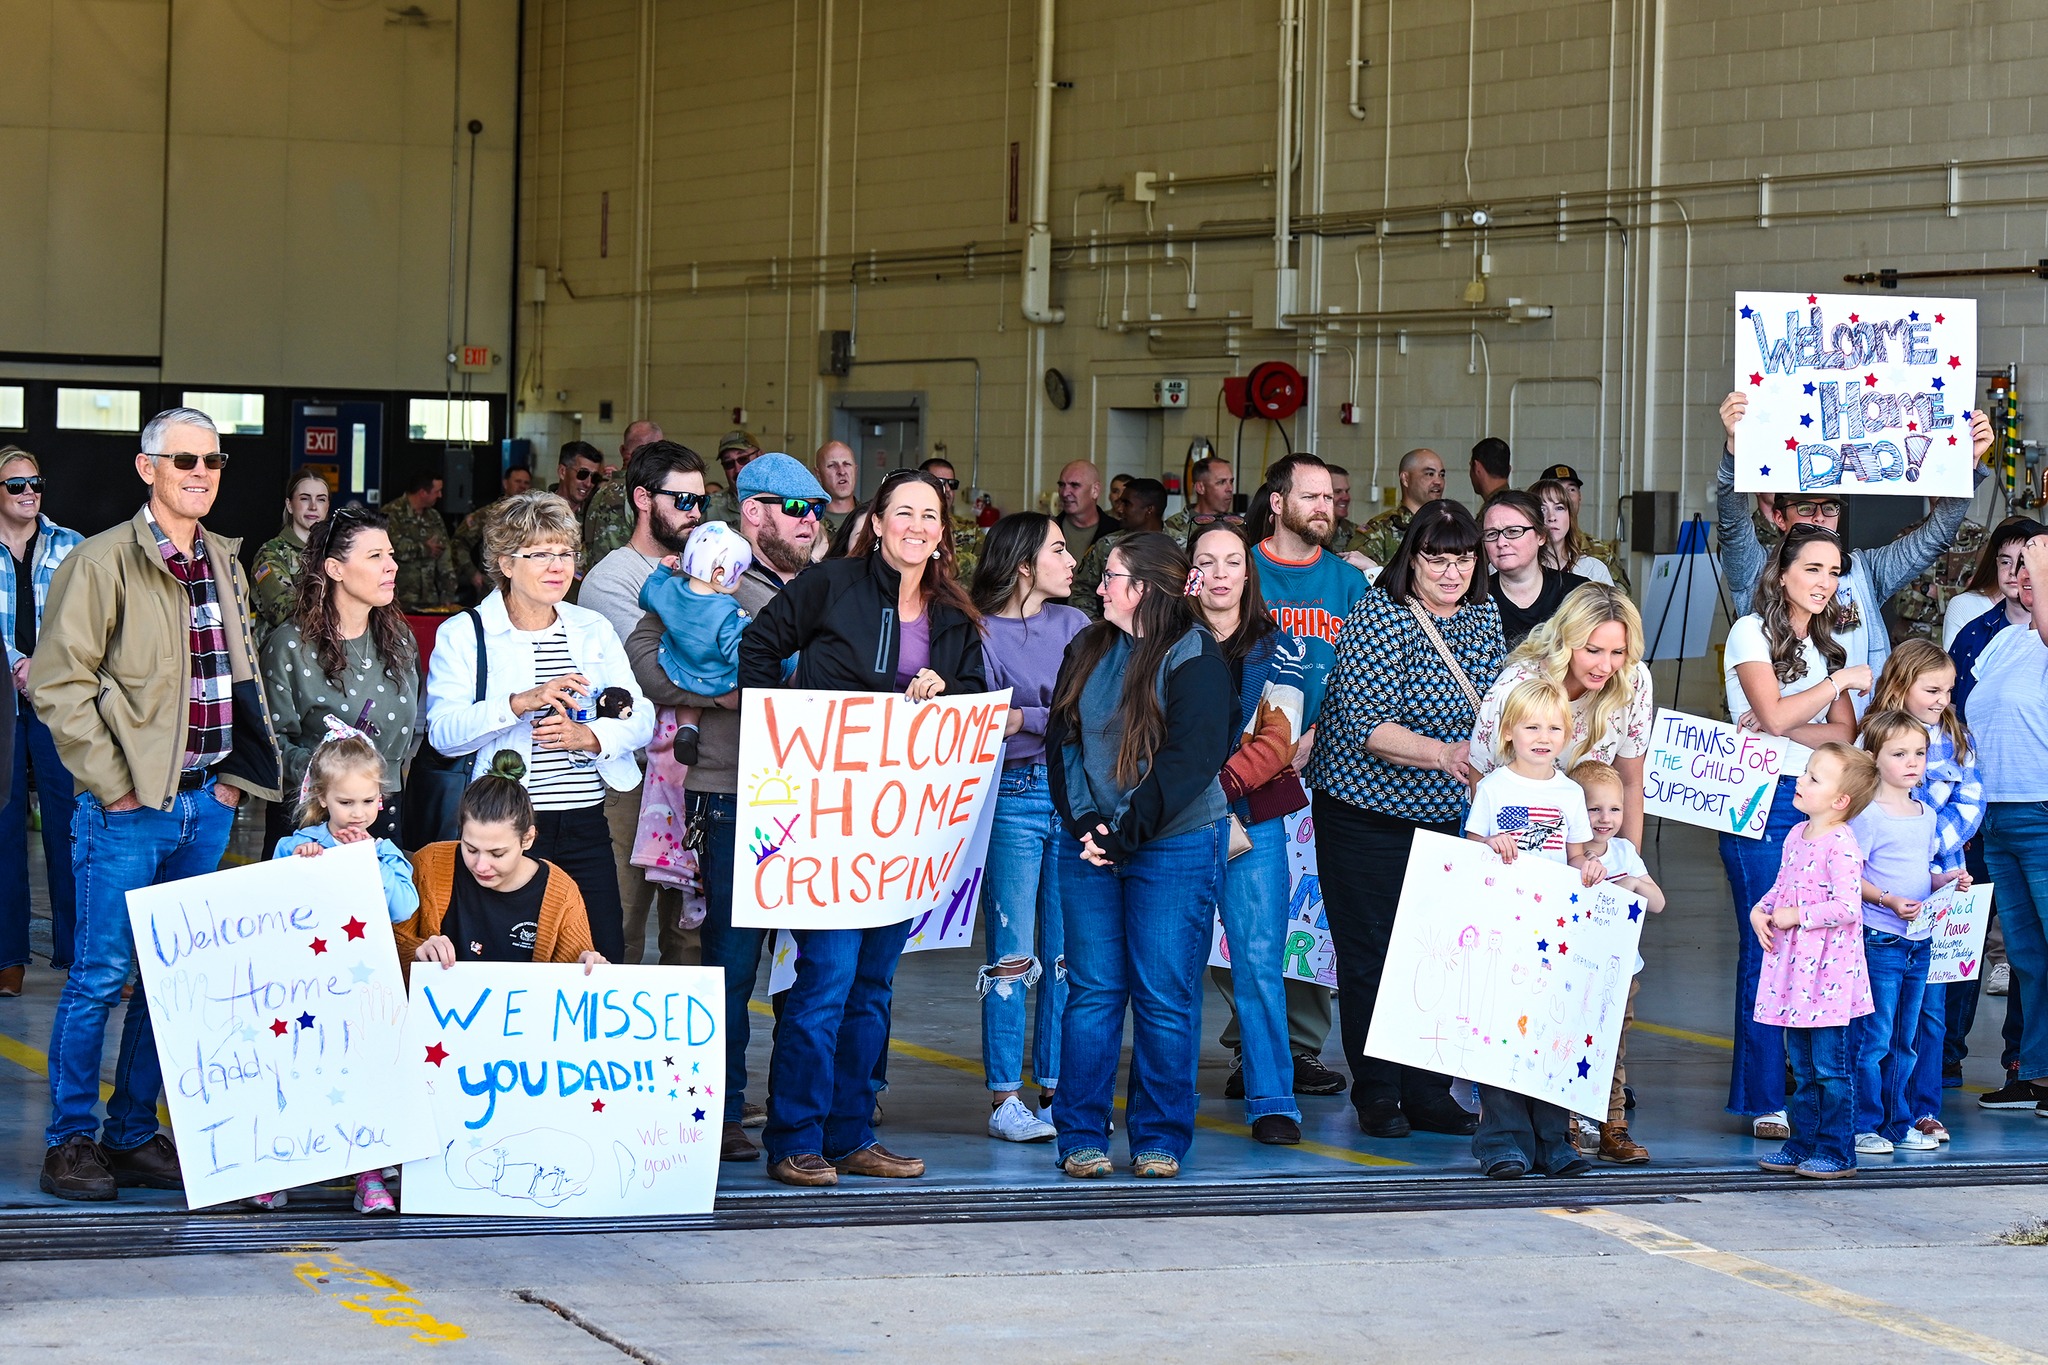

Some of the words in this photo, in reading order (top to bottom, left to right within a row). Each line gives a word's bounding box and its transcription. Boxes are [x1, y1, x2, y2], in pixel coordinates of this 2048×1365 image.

[464, 347, 488, 366] EXIT
[306, 432, 335, 451] EXIT
[1797, 433, 1933, 491] DAD!
[1265, 598, 1323, 608] MIAMI
[763, 695, 1009, 772] WELCOME
[1663, 717, 1736, 758] THANKS
[1739, 736, 1780, 775] FOR
[1654, 749, 1683, 771] THE
[1691, 754, 1745, 784] CHILD
[809, 776, 981, 839] HOME
[1643, 771, 1731, 816] SUPPORT
[754, 837, 966, 910] CRISPIN!
[151, 900, 319, 968] Welcome
[1592, 916, 1611, 927] MOM
[1943, 918, 1971, 937] have
[1950, 947, 1975, 962] Daddy
[423, 986, 527, 1037] WE
[553, 988, 715, 1046] MISSED
[557, 1059, 655, 1098] DAD!!
[197, 1116, 241, 1178] I
[679, 1121, 704, 1144] love
